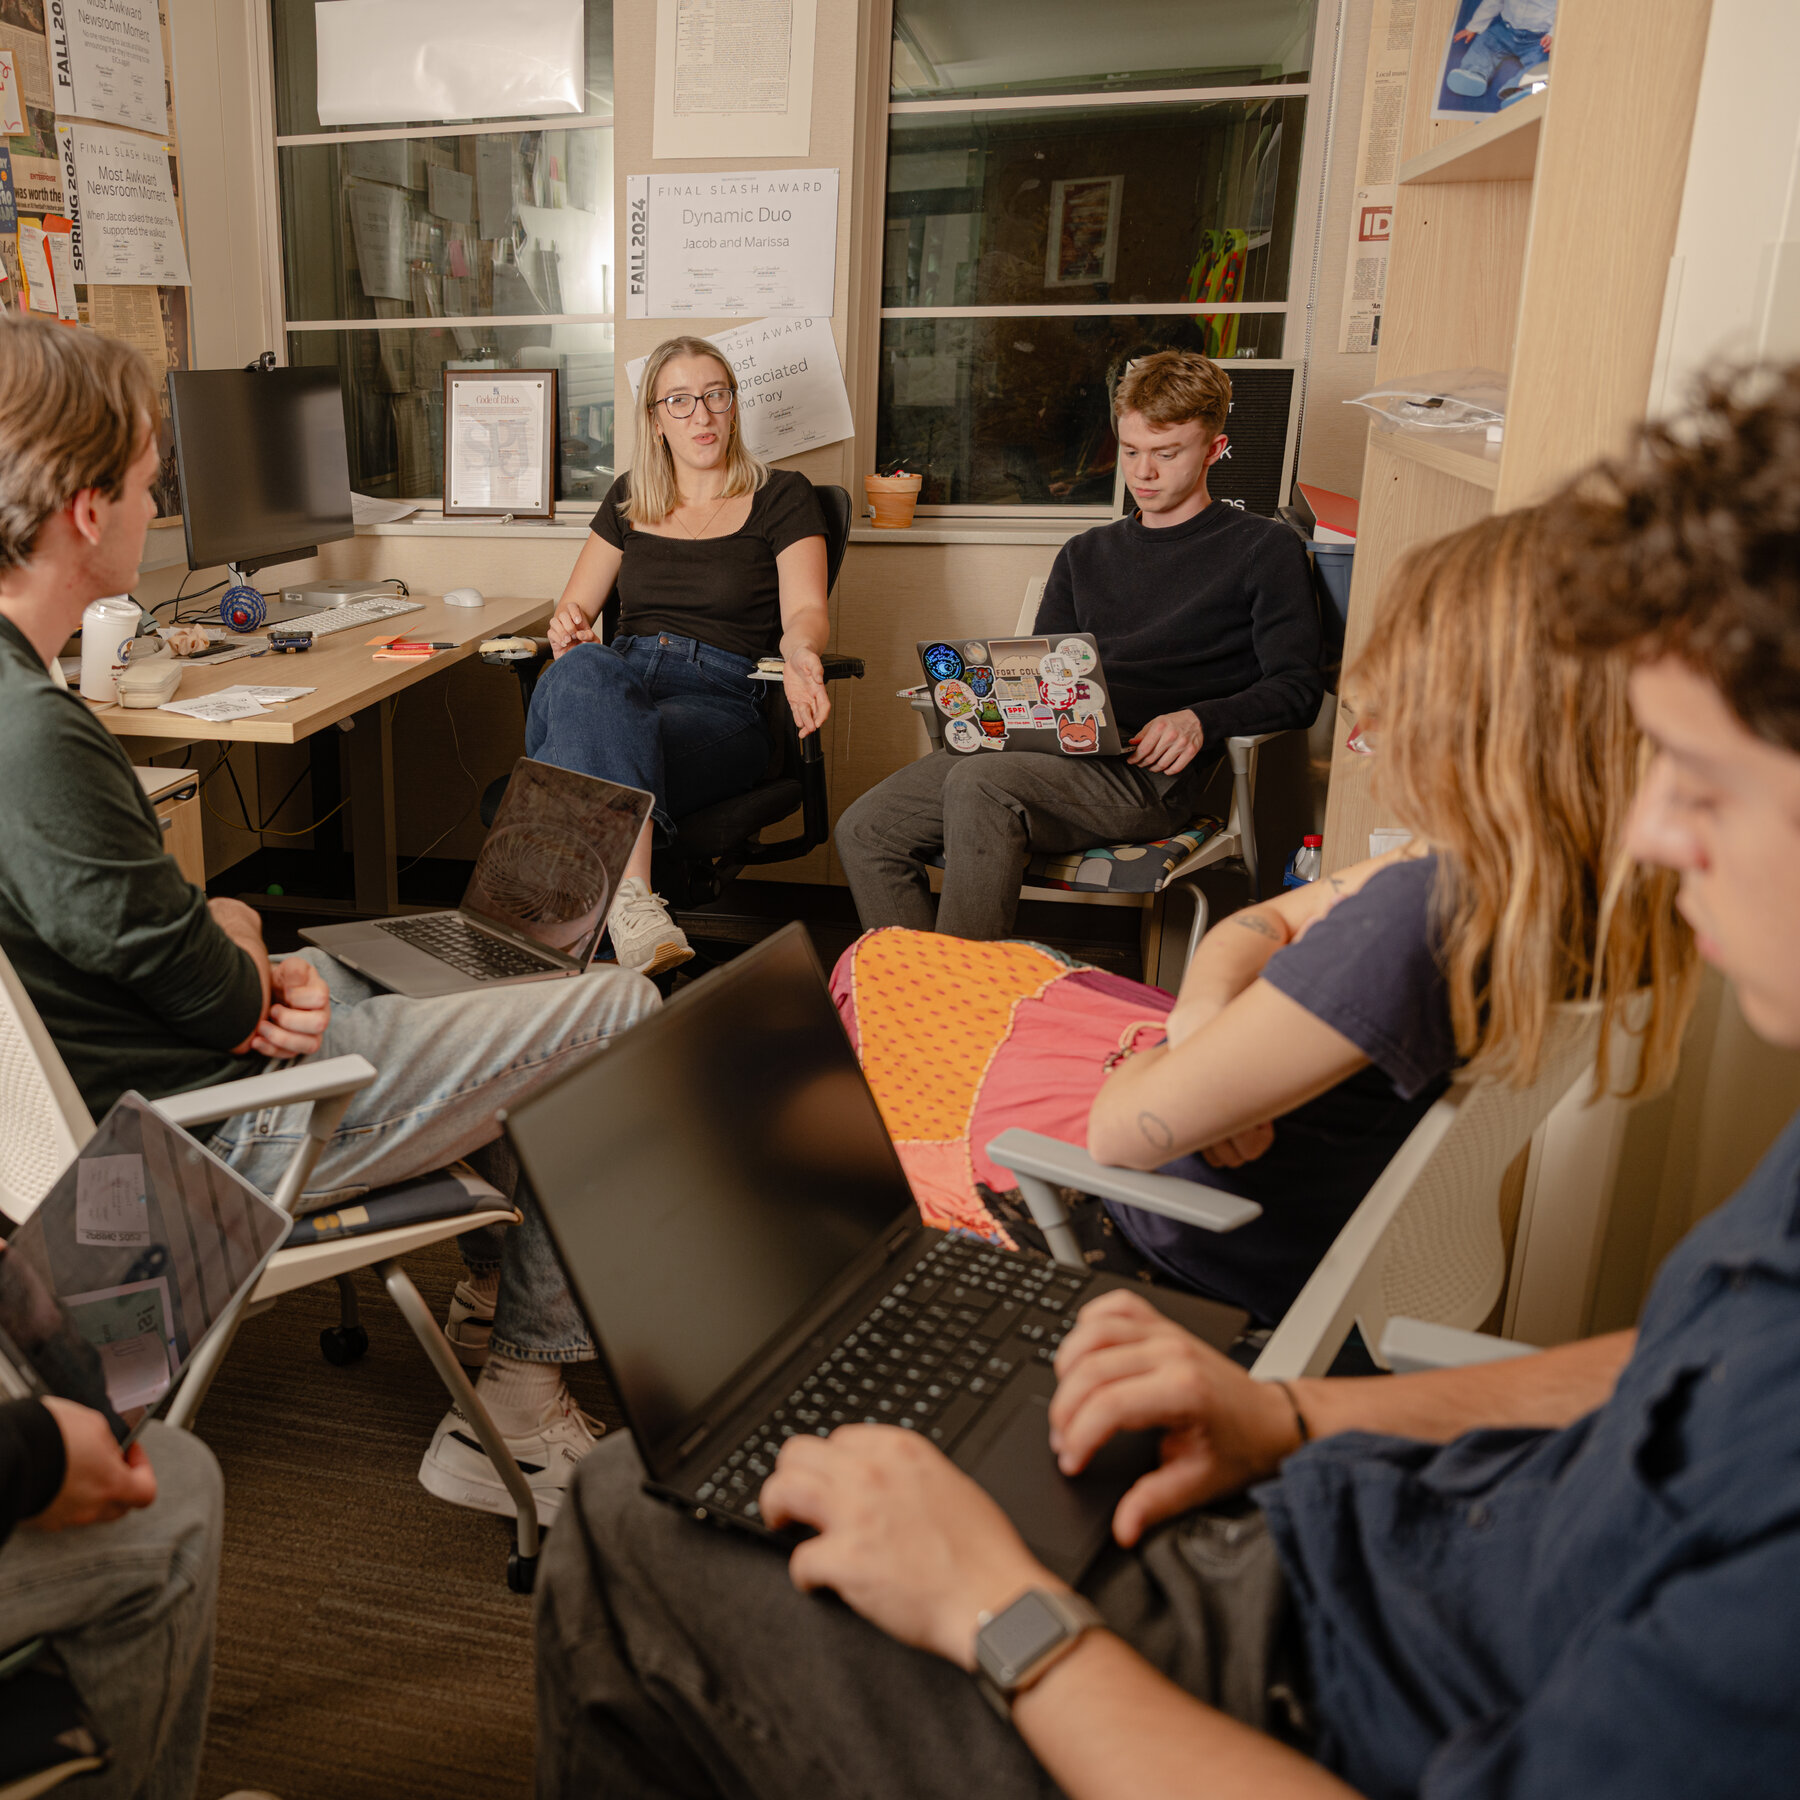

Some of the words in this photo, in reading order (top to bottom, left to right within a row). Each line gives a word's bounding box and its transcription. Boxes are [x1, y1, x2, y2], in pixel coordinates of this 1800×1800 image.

[51, 0, 65, 31] 20
[78, 9, 122, 31] Newsroom
[109, 0, 142, 21] Awkward
[55, 35, 71, 87] FALL
[63, 137, 77, 191] 2024
[80, 142, 111, 156] FINAL
[114, 146, 139, 160] SLASH
[143, 151, 164, 166] AWARD
[29, 173, 57, 183] ENTERPRISE
[98, 165, 124, 182] Most
[125, 168, 157, 187] Awkward
[28, 187, 49, 202] worth
[49, 188, 62, 203] the
[87, 180, 139, 198] Newsroom
[657, 185, 702, 198] FINAL
[710, 183, 759, 196] SLASH
[767, 181, 823, 194] AWARD
[86, 209, 105, 221] When
[106, 211, 128, 222] Jacob
[127, 213, 145, 224] asked
[631, 197, 647, 248] 2024
[681, 207, 754, 227] Dynamic
[757, 206, 792, 223] Duo
[69, 194, 84, 272] SPRING
[102, 226, 138, 237] supported
[138, 228, 149, 237] the
[682, 237, 717, 250] Jacob
[719, 236, 742, 249] and
[744, 235, 790, 249] Marissa
[631, 250, 645, 295] FALL
[725, 336, 755, 354] ASH
[762, 318, 813, 342] AWARD
[733, 354, 757, 373] ost
[738, 356, 809, 392] preciated
[476, 394, 492, 404] Code
[500, 394, 520, 405] Ethics
[740, 394, 756, 411] nd
[757, 389, 783, 404] Tory
[996, 668, 1016, 676] FORT
[1019, 668, 1041, 676] COLL
